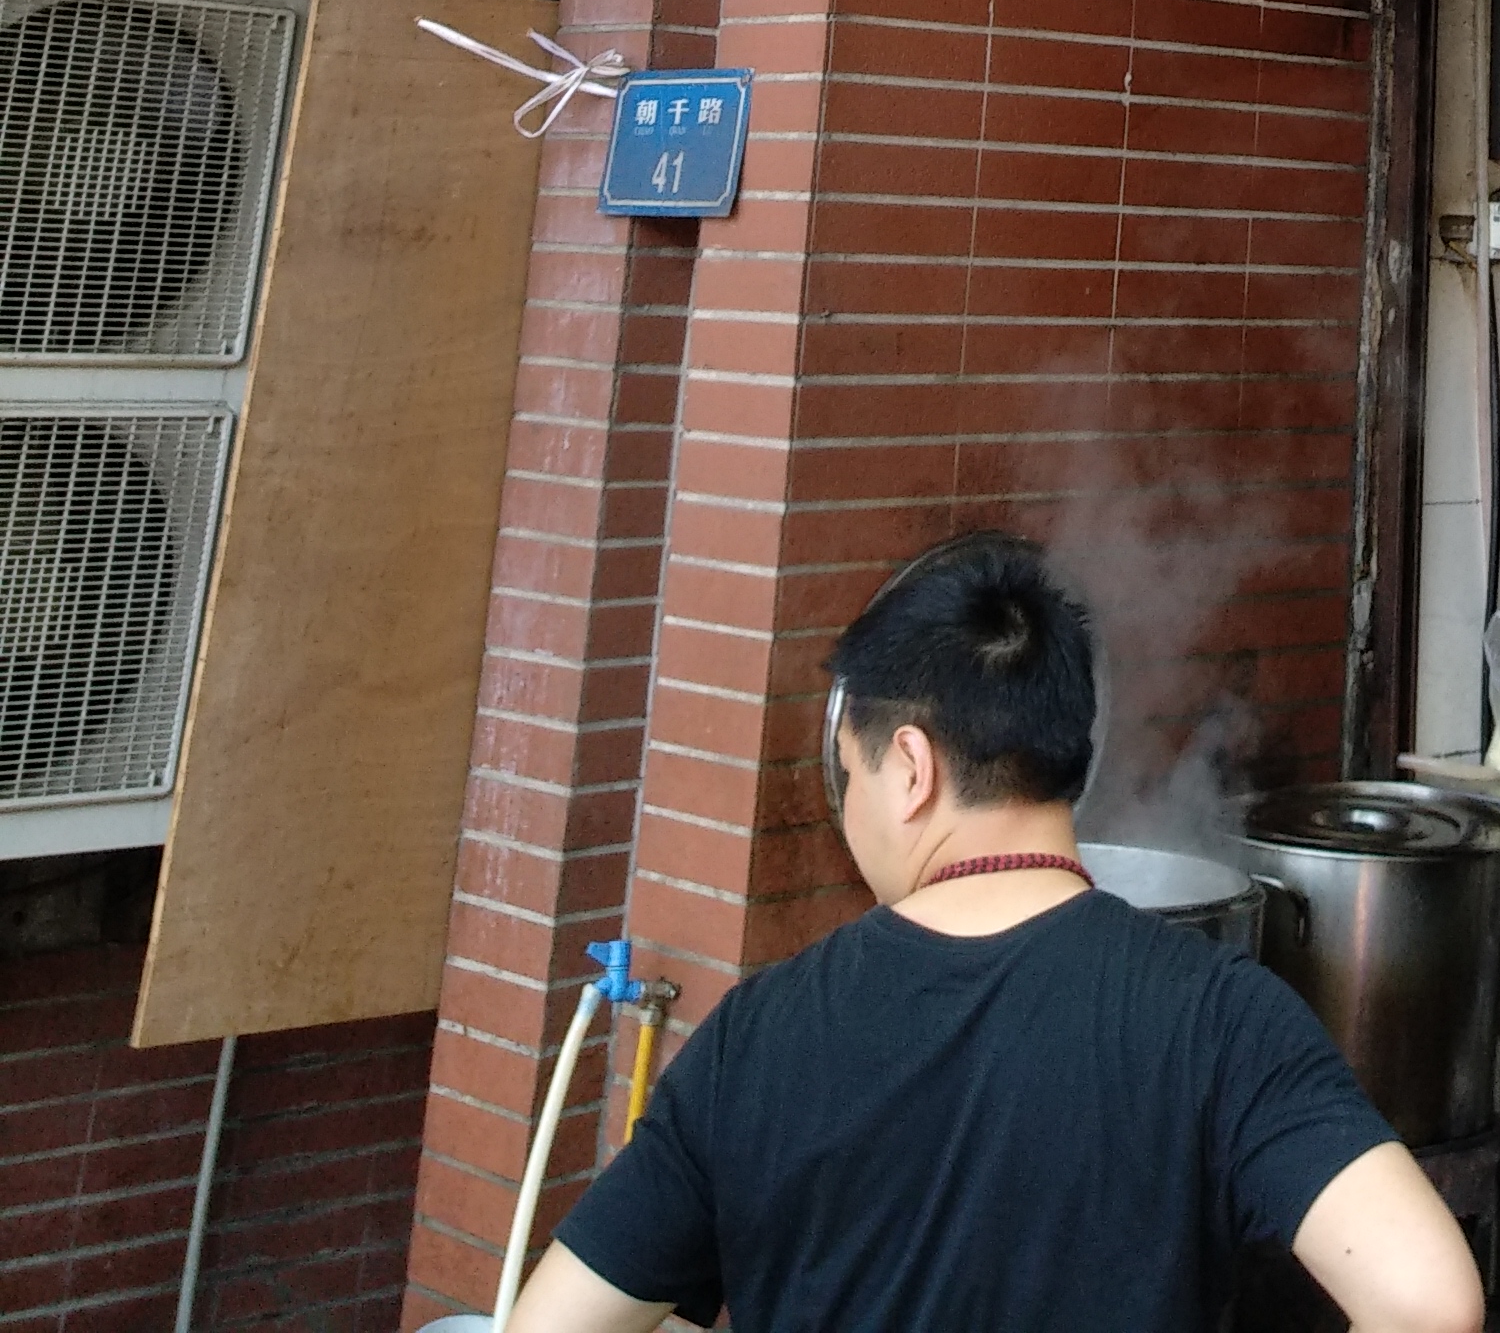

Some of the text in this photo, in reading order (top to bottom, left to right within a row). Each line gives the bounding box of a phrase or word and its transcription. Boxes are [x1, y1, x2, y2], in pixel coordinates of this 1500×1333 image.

[635, 97, 724, 126] 朝千路
[651, 150, 684, 194] 41
